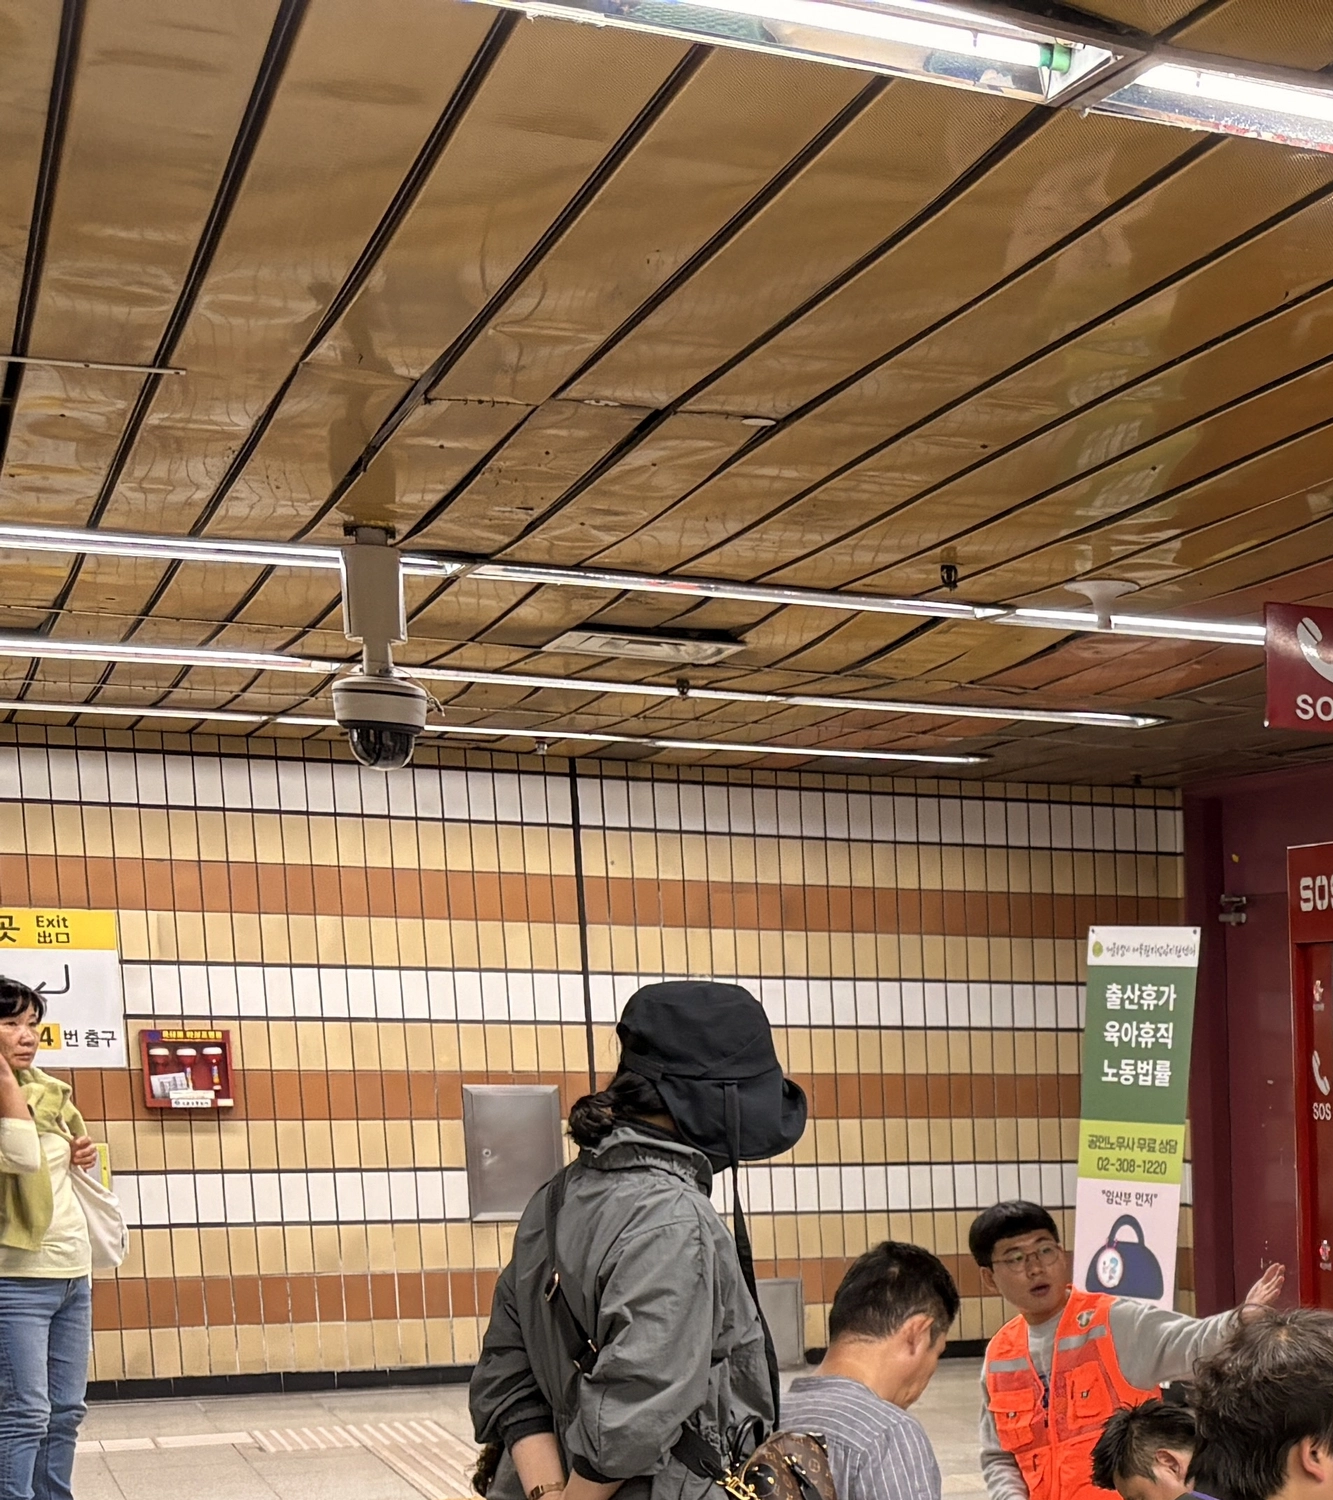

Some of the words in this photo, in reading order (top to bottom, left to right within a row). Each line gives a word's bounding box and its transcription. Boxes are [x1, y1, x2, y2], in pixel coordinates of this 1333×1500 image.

[36, 915, 68, 928] Exit
[37, 930, 70, 943] 出口
[1105, 983, 1177, 1011] 출산휴가
[40, 1026, 53, 1047] 4
[64, 1029, 79, 1047] 번
[85, 1029, 117, 1048] 출구
[1103, 1020, 1173, 1049] 육아휴직
[1101, 1059, 1171, 1087] 노동법률
[1312, 1103, 1332, 1120] SOS
[1088, 1134, 1135, 1151] 공인노무사
[1137, 1137, 1157, 1153] 무료
[1158, 1138, 1178, 1154] 상담
[1097, 1156, 1167, 1175] 02-308-1220
